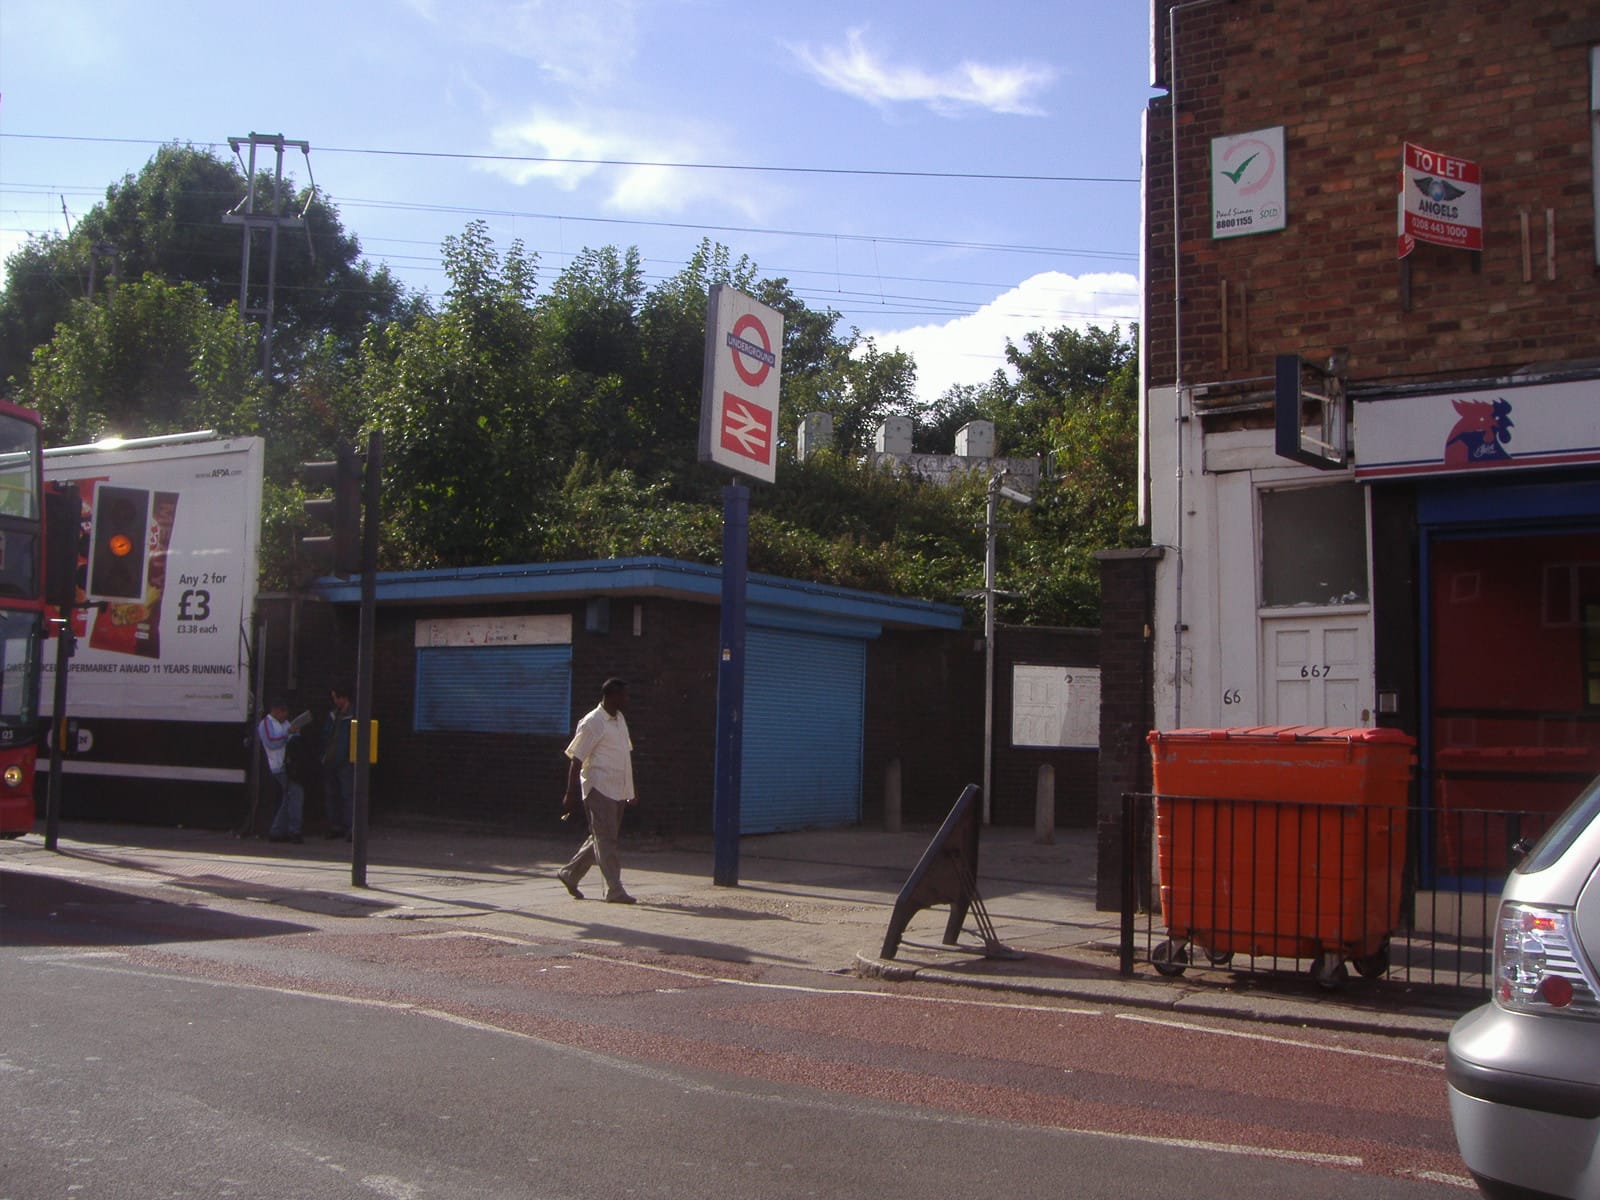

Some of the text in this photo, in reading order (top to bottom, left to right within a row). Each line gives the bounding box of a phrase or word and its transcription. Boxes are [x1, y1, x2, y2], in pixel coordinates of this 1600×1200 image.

[1414, 150, 1466, 179] TO LET
[1260, 208, 1278, 219] SOLD
[1419, 199, 1458, 219] ANGELS
[1431, 221, 1445, 234] 443
[1446, 226, 1468, 238] 1000
[727, 334, 775, 366] UNDERGROUND
[179, 571, 227, 588] Any 2 for
[177, 589, 210, 621] £3
[177, 623, 218, 634] £3.38 each
[65, 663, 117, 673] UPERMARKET
[118, 664, 150, 673] AWARD
[153, 664, 160, 673] 11
[163, 664, 190, 674] YEARS
[1300, 664, 1331, 678] 667
[1223, 689, 1241, 705] 66
